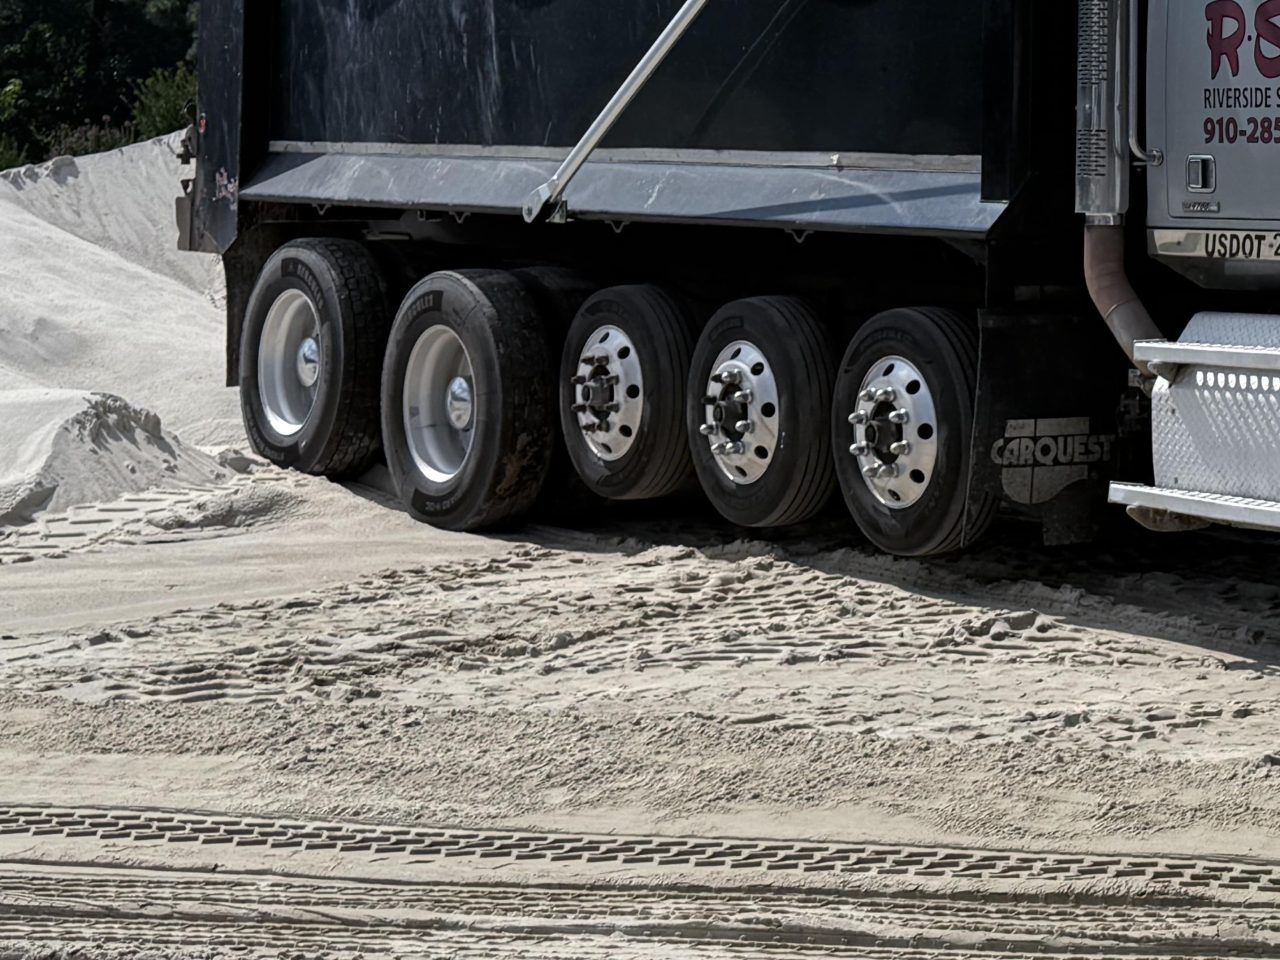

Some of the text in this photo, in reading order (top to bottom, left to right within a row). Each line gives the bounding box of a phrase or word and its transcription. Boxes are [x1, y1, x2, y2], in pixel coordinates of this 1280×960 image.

[1204, 87, 1272, 109] RIVERSIDE
[1204, 232, 1266, 259] USDOT
[990, 434, 1116, 466] CARQUEST
